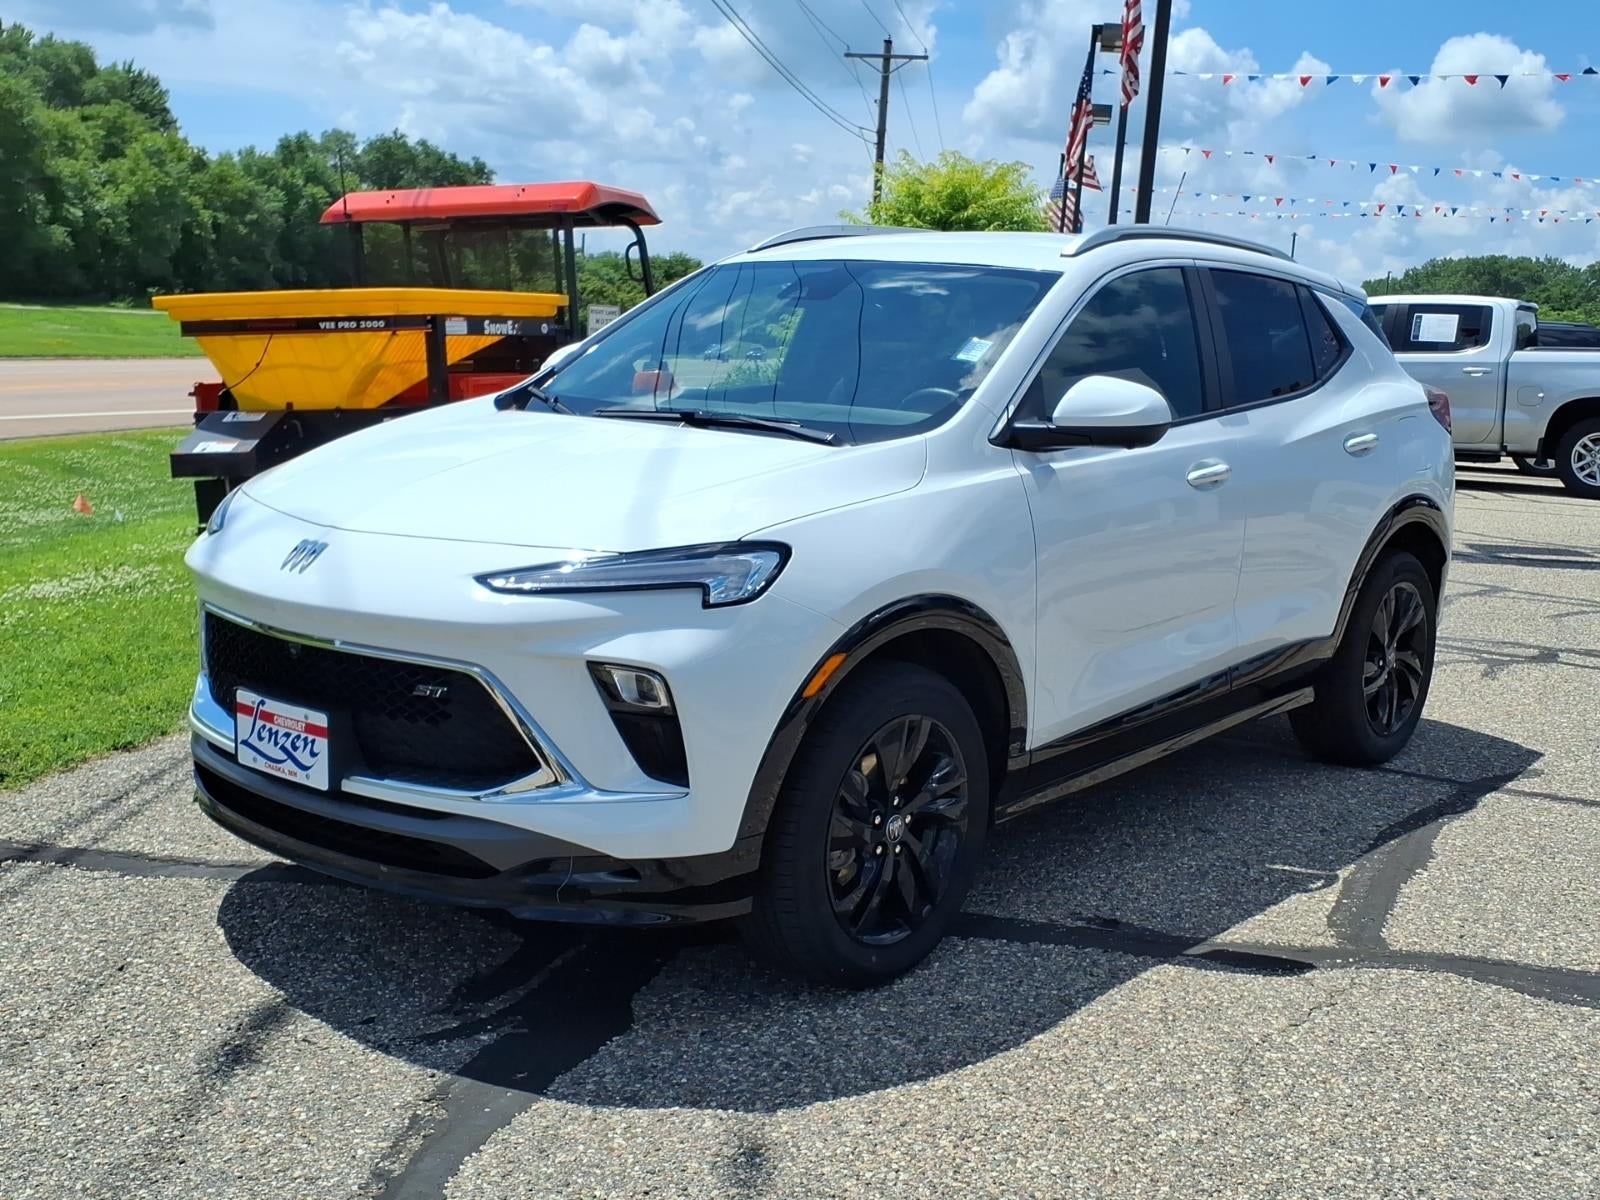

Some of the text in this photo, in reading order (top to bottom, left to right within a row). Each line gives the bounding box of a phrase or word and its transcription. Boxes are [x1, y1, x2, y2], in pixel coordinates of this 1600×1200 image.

[319, 321, 336, 329] VEE
[337, 321, 357, 329] PRO
[412, 684, 448, 698] ST
[273, 715, 306, 732] CHEVROLET
[239, 699, 321, 772] Lenzen
[264, 761, 287, 776] CHASKA,
